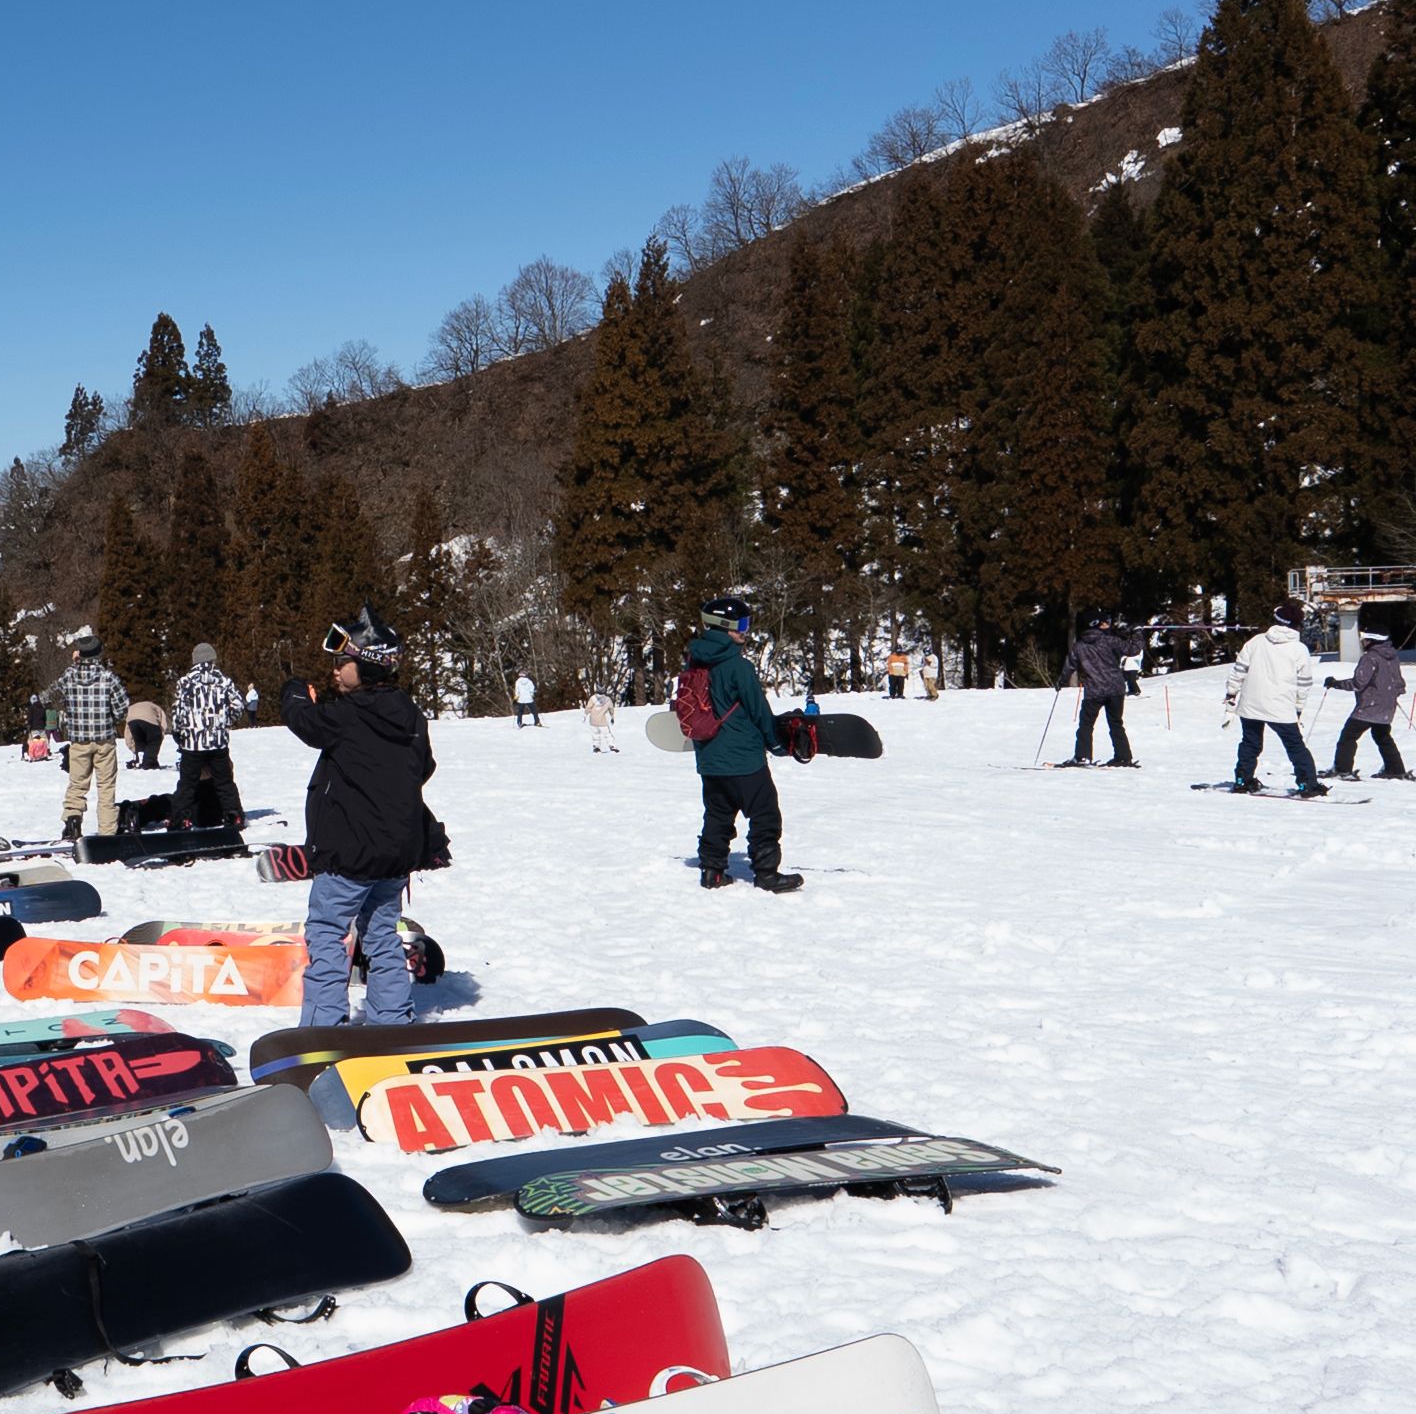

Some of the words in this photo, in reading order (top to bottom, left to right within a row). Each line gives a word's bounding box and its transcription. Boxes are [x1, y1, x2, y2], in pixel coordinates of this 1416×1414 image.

[385, 1061, 730, 1153] ATOMIC
[819, 1139, 1001, 1171] Sepia
[582, 1156, 852, 1202] Monster
